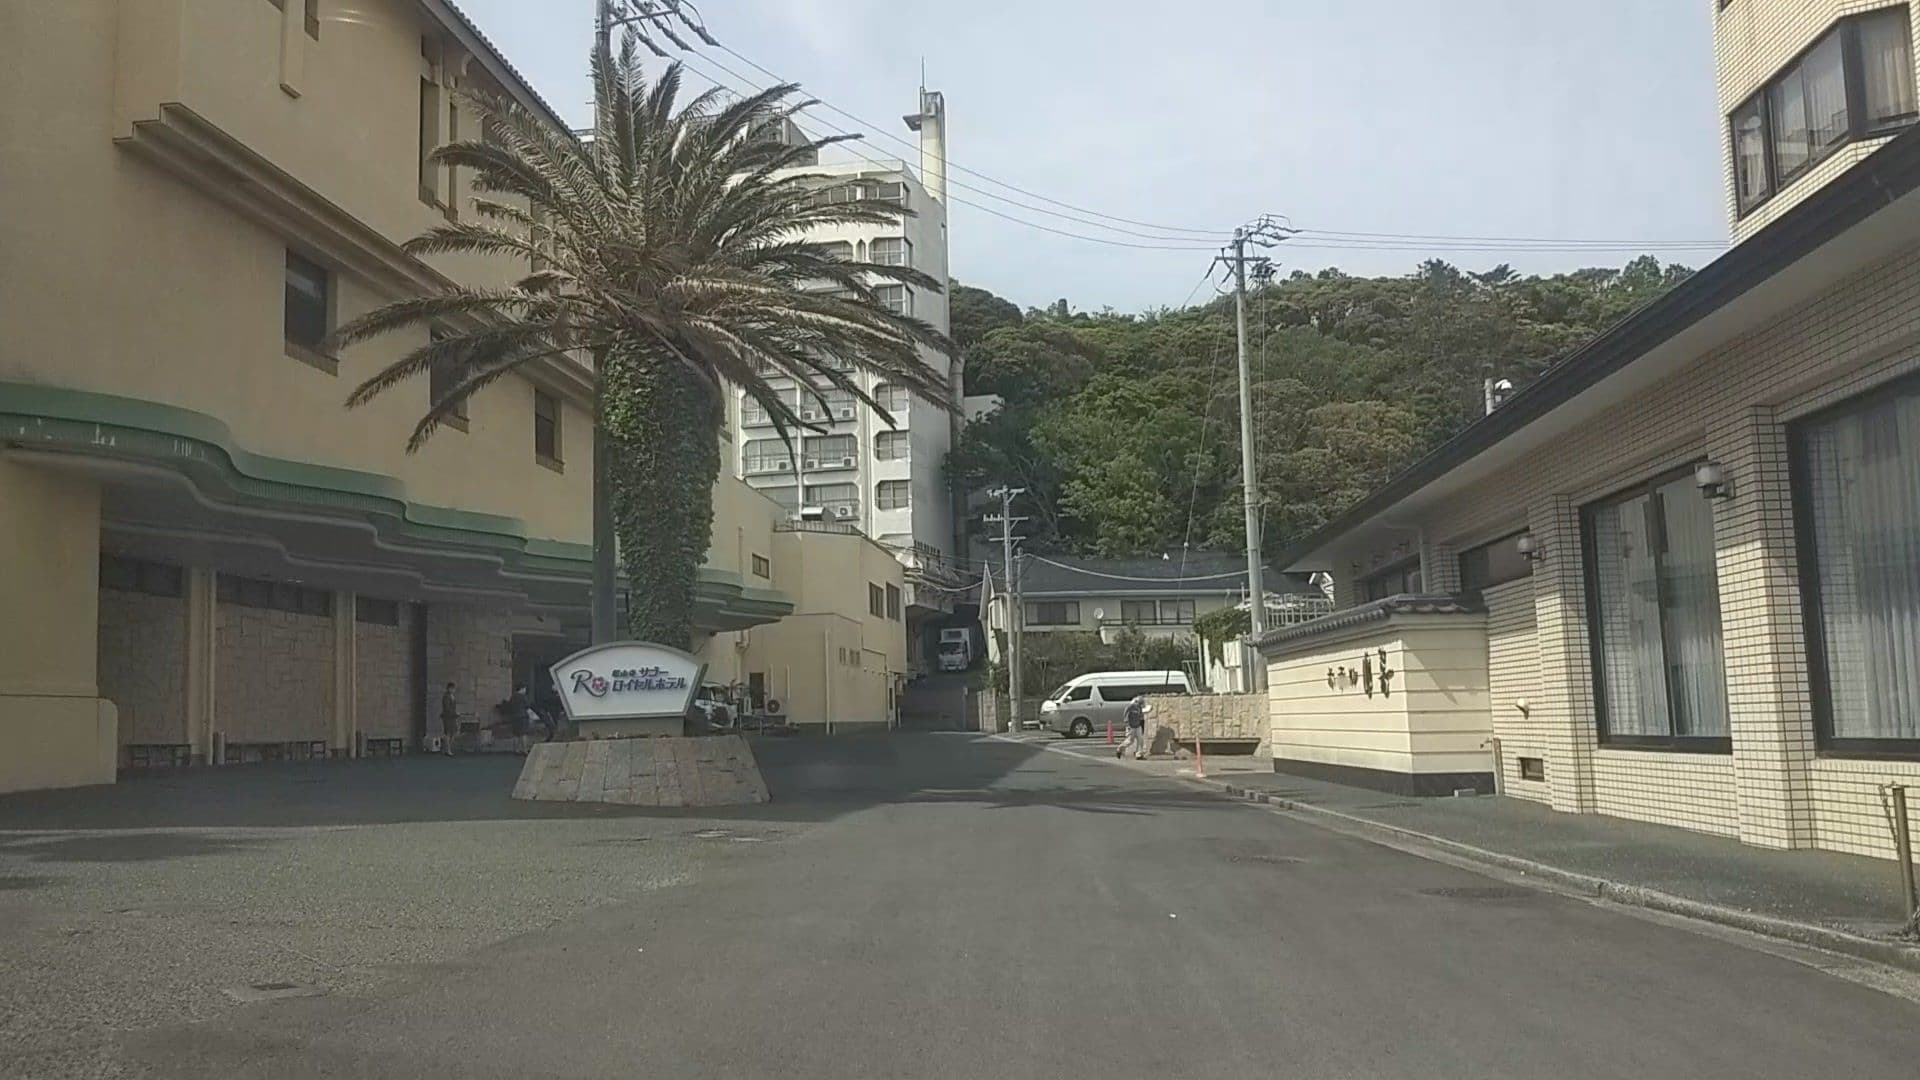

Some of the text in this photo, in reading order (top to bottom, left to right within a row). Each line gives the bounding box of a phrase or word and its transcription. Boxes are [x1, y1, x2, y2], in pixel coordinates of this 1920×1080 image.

[612, 677, 687, 692] ロイヤルホテル
